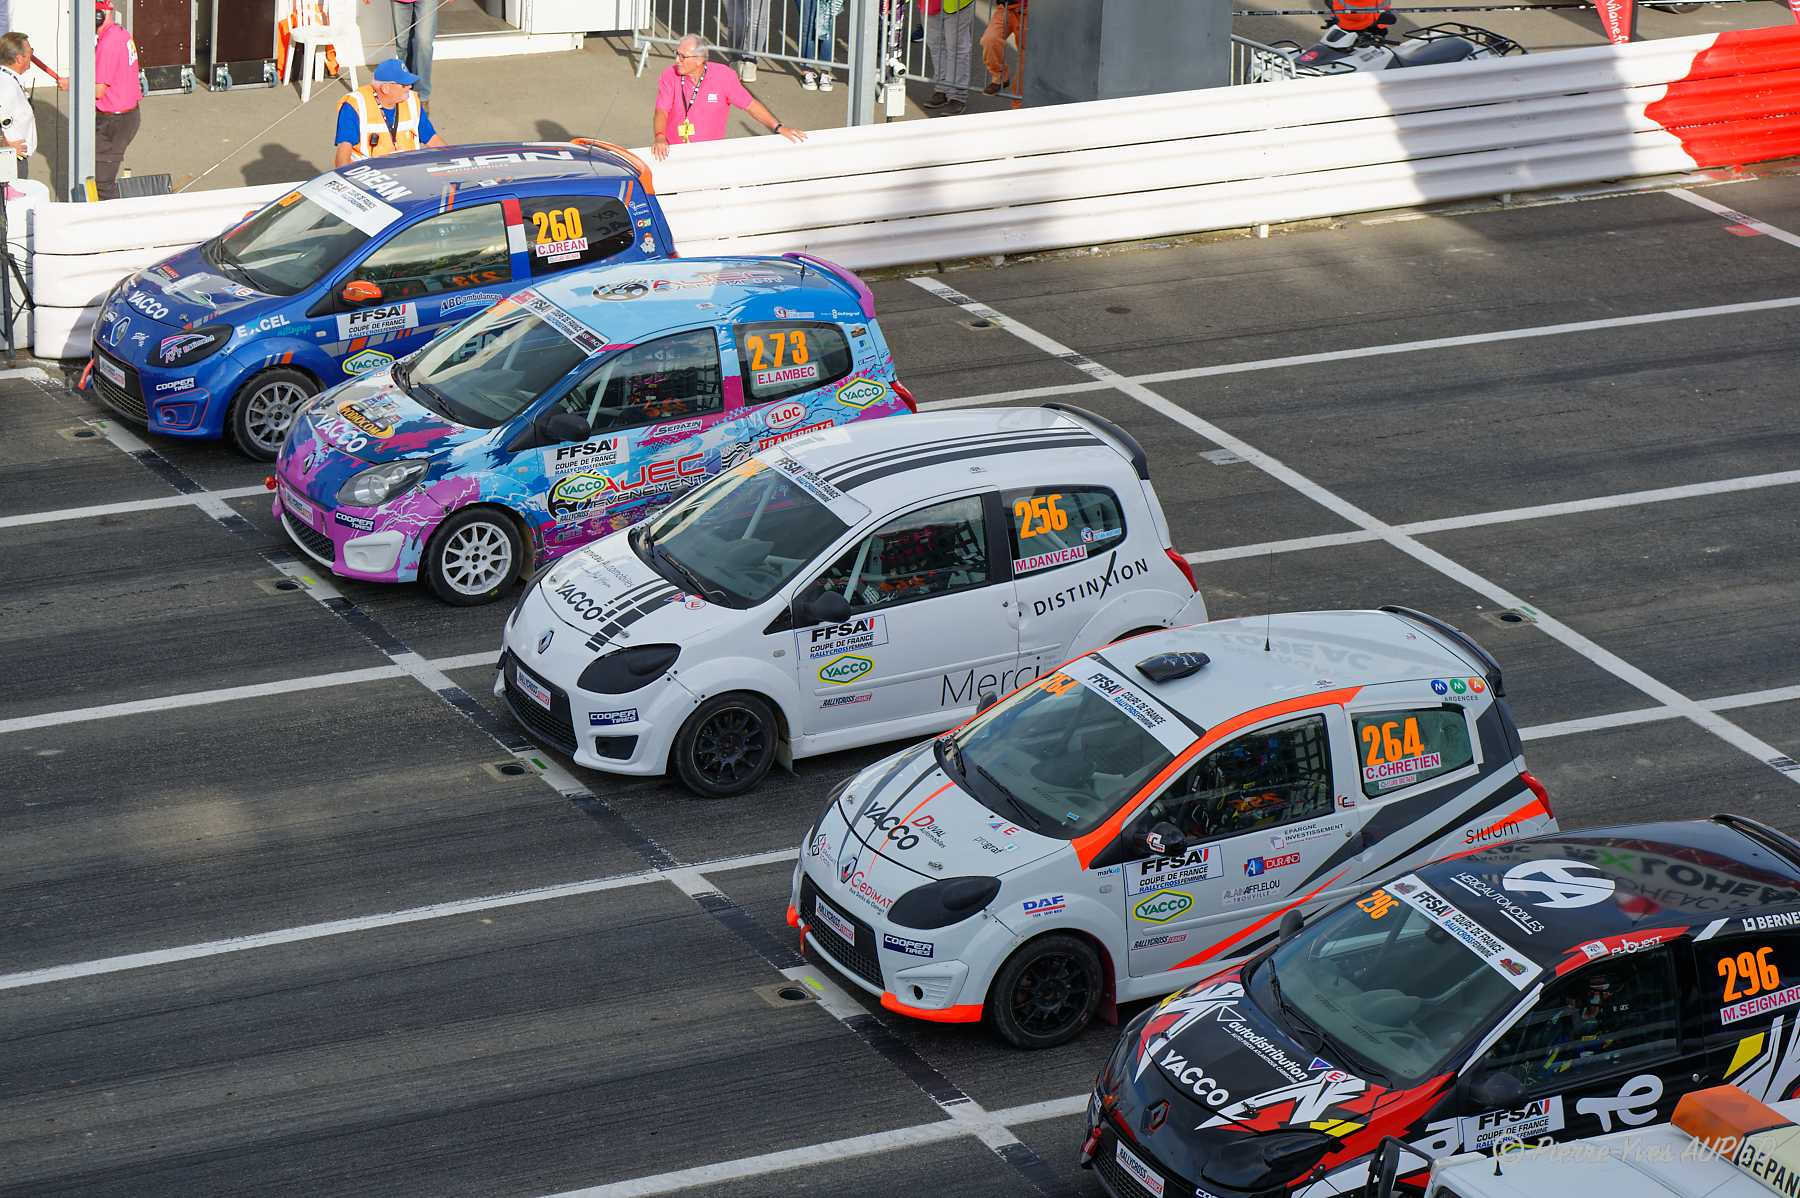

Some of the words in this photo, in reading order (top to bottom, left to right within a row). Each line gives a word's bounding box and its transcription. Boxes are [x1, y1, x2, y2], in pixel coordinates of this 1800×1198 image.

[426, 150, 574, 173] JAN
[532, 207, 583, 244] 260
[538, 239, 586, 255] C.DREAN
[128, 290, 169, 320] YACCO
[349, 304, 401, 324] FFSA
[746, 330, 809, 372] 273
[350, 358, 389, 371] YACCO
[156, 377, 194, 391] COOPER
[757, 366, 815, 385] E.LAMBEC
[843, 387, 880, 401] YACCO
[775, 407, 801, 422] LOC
[315, 414, 368, 452] YACCO
[656, 421, 702, 436] SERAZIN
[557, 440, 611, 460] FFSA
[555, 461, 579, 470] COUPE
[591, 453, 616, 463] FRANCE
[563, 481, 602, 495] YACCO
[336, 512, 374, 527] COOPER
[1014, 493, 1068, 540] 256
[1015, 547, 1086, 573] M.DANVEAU
[1034, 551, 1149, 616] DISTINXION
[555, 579, 603, 620] YACCO
[811, 620, 868, 642] FFSA
[810, 643, 833, 653] COUPE
[836, 640, 846, 648] DE
[847, 634, 873, 645] FRANCE
[826, 662, 868, 678] YACCO
[941, 656, 1041, 706] Merci
[1088, 673, 1121, 693] FFSA
[590, 709, 636, 720] COOPER
[1362, 716, 1424, 766] 264
[1366, 754, 1441, 780] C.CHRETIEN
[864, 802, 919, 851] YACCO
[1284, 823, 1317, 835] EPARGNE
[1285, 823, 1343, 841] INVESTISSEMENT
[1141, 850, 1202, 876] FFSA
[1266, 853, 1299, 868] DURAND
[1139, 875, 1165, 887] COUPE
[1167, 872, 1178, 881] DE
[1179, 866, 1208, 878] FRANCE
[1023, 895, 1064, 910] DAF
[1142, 899, 1187, 916] YACCO
[1355, 889, 1401, 920] 296
[1412, 891, 1449, 918] FFSA
[1757, 910, 1800, 929] BERNE
[884, 934, 932, 950] COOPER
[1452, 914, 1477, 930] COUPE
[1471, 926, 1483, 937] DE
[1479, 933, 1505, 954] FRANCE
[1717, 946, 1780, 1003] 296
[1228, 1021, 1308, 1081] autodistribution
[1159, 1049, 1229, 1106] YACCO
[1479, 1102, 1543, 1130] FFSA
[1477, 1129, 1504, 1143] COUPE
[1506, 1127, 1517, 1135] DE
[1518, 1118, 1549, 1132] FRANCE
[1741, 1144, 1800, 1198] DEPAN
